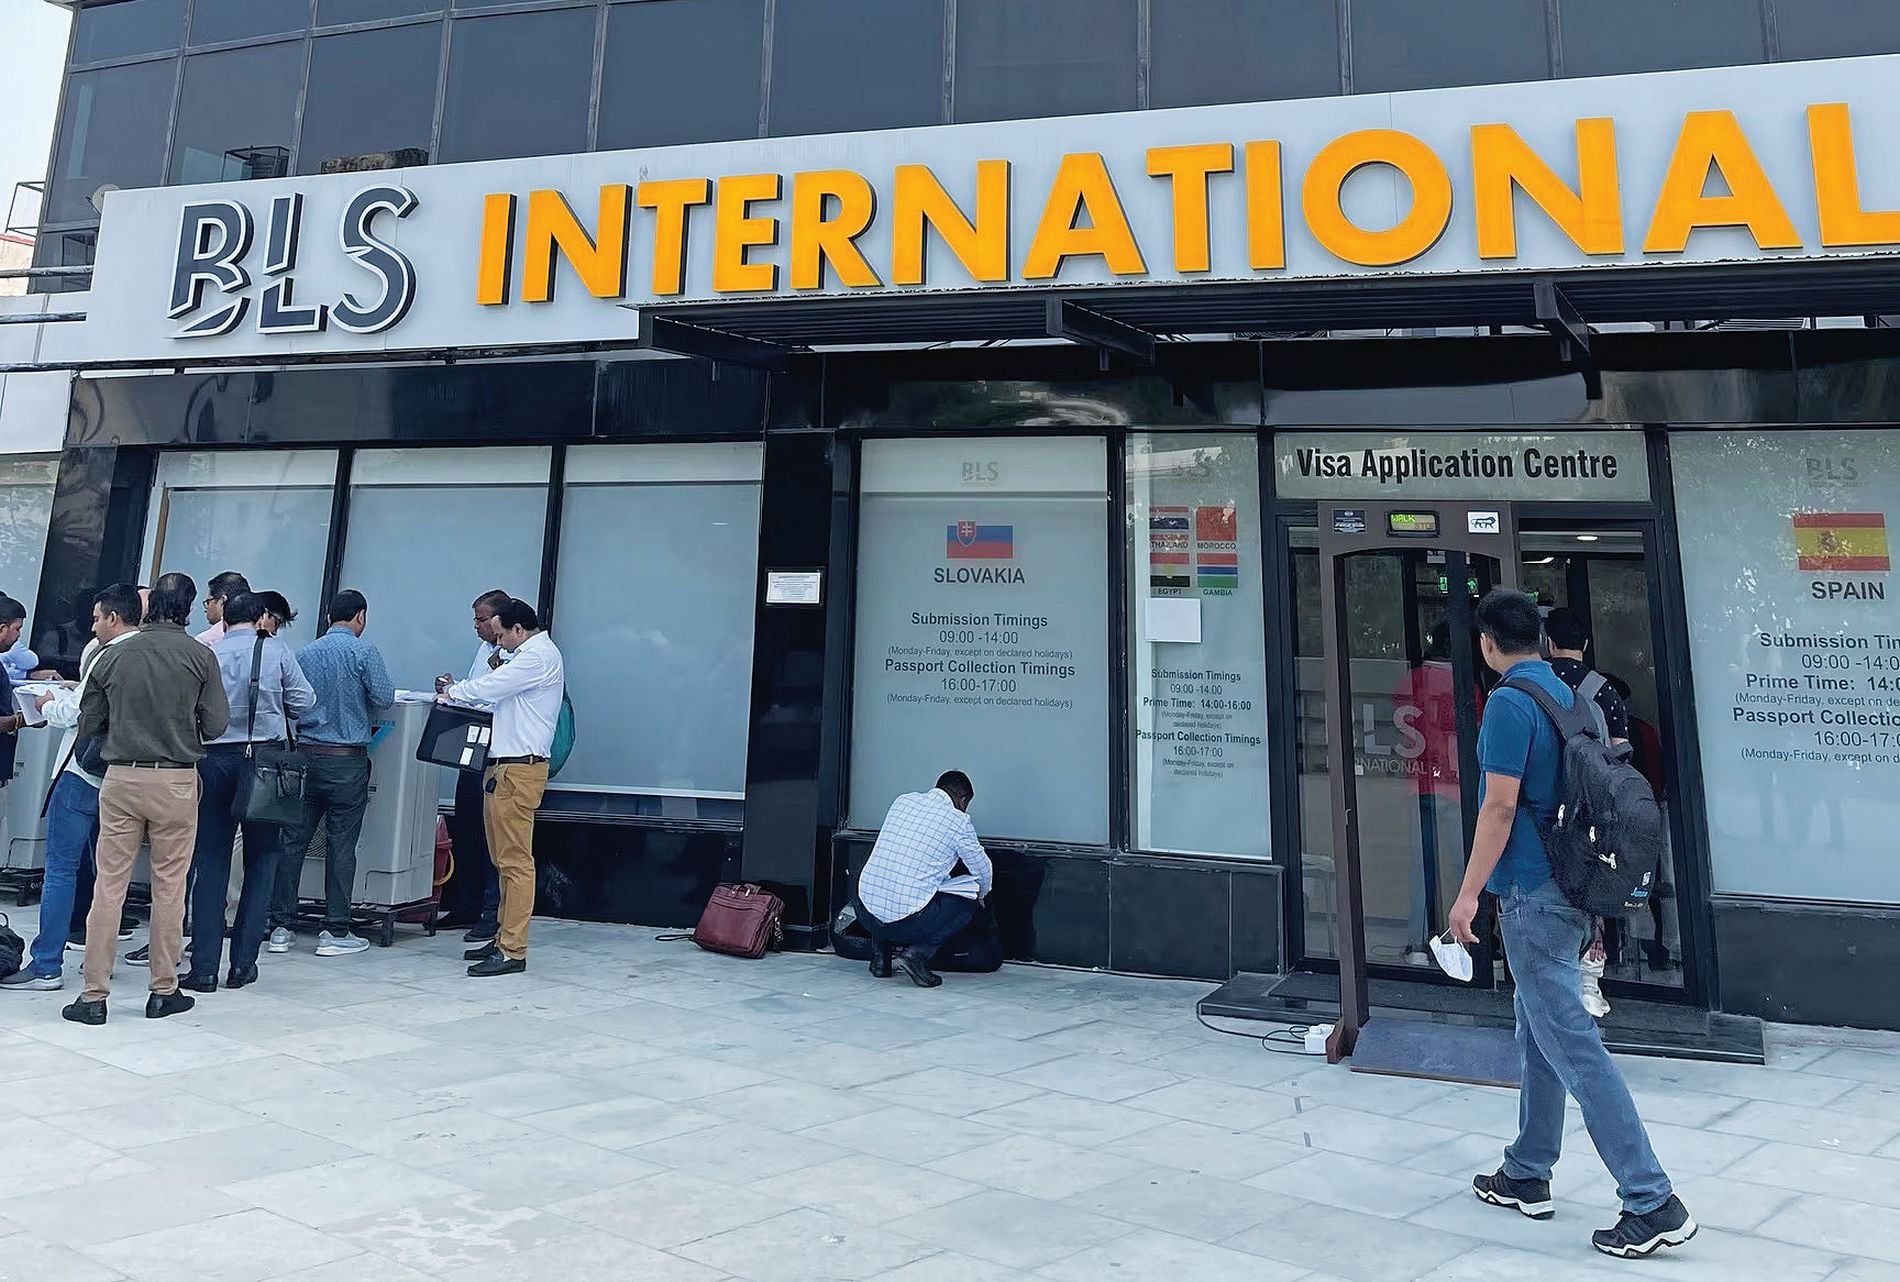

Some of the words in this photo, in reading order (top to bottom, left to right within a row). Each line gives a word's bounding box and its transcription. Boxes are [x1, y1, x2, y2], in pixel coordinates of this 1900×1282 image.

[165, 184, 419, 340] BLS
[476, 101, 1900, 306] INTERNATIONAL
[961, 461, 999, 481] BLS
[1296, 448, 1352, 479] Visa
[1362, 447, 1514, 485] Application
[1523, 447, 1619, 479] Centre
[1805, 457, 1859, 481] BLS
[1197, 542, 1237, 550] MOROCCO
[934, 567, 1026, 584] SLOVAKIA
[1203, 588, 1233, 596] GAMBIA
[1811, 581, 1885, 600] SPAIN
[911, 612, 990, 626] Submission
[994, 613, 1048, 629] Timings
[939, 630, 974, 644] 09:00
[978, 631, 1018, 644] -14:00
[1760, 632, 1869, 649] Submission
[954, 648, 982, 658] except
[996, 648, 1032, 658] declared
[1034, 649, 1073, 660] holidays)
[1802, 653, 1850, 670] 09:00
[885, 659, 944, 675] Passport
[948, 660, 1016, 674] Collection
[1020, 662, 1075, 679] Timings
[1151, 669, 1203, 680] Submission
[1205, 671, 1241, 683] Timings
[942, 678, 1016, 692] 16:00-17:00
[1746, 674, 1799, 689] Prime
[1803, 675, 1856, 690] Time:
[954, 696, 982, 706] except
[996, 697, 1032, 706] declared
[1034, 698, 1073, 709] holidays)
[1143, 697, 1169, 707] Prime
[1171, 698, 1195, 708] Time:
[1201, 700, 1251, 710] 14:00-16:00
[1735, 692, 1825, 706] (Monday-Friday,
[1827, 695, 1865, 707] except
[1868, 698, 1882, 706] on
[1733, 707, 1816, 727] Passport
[1136, 729, 1175, 742] Passport
[1177, 731, 1222, 743] Collection
[1225, 733, 1261, 747] Timings
[1741, 748, 1831, 762] (Monday-Friday,
[1834, 751, 1872, 764] except
[1875, 753, 1890, 763] on
